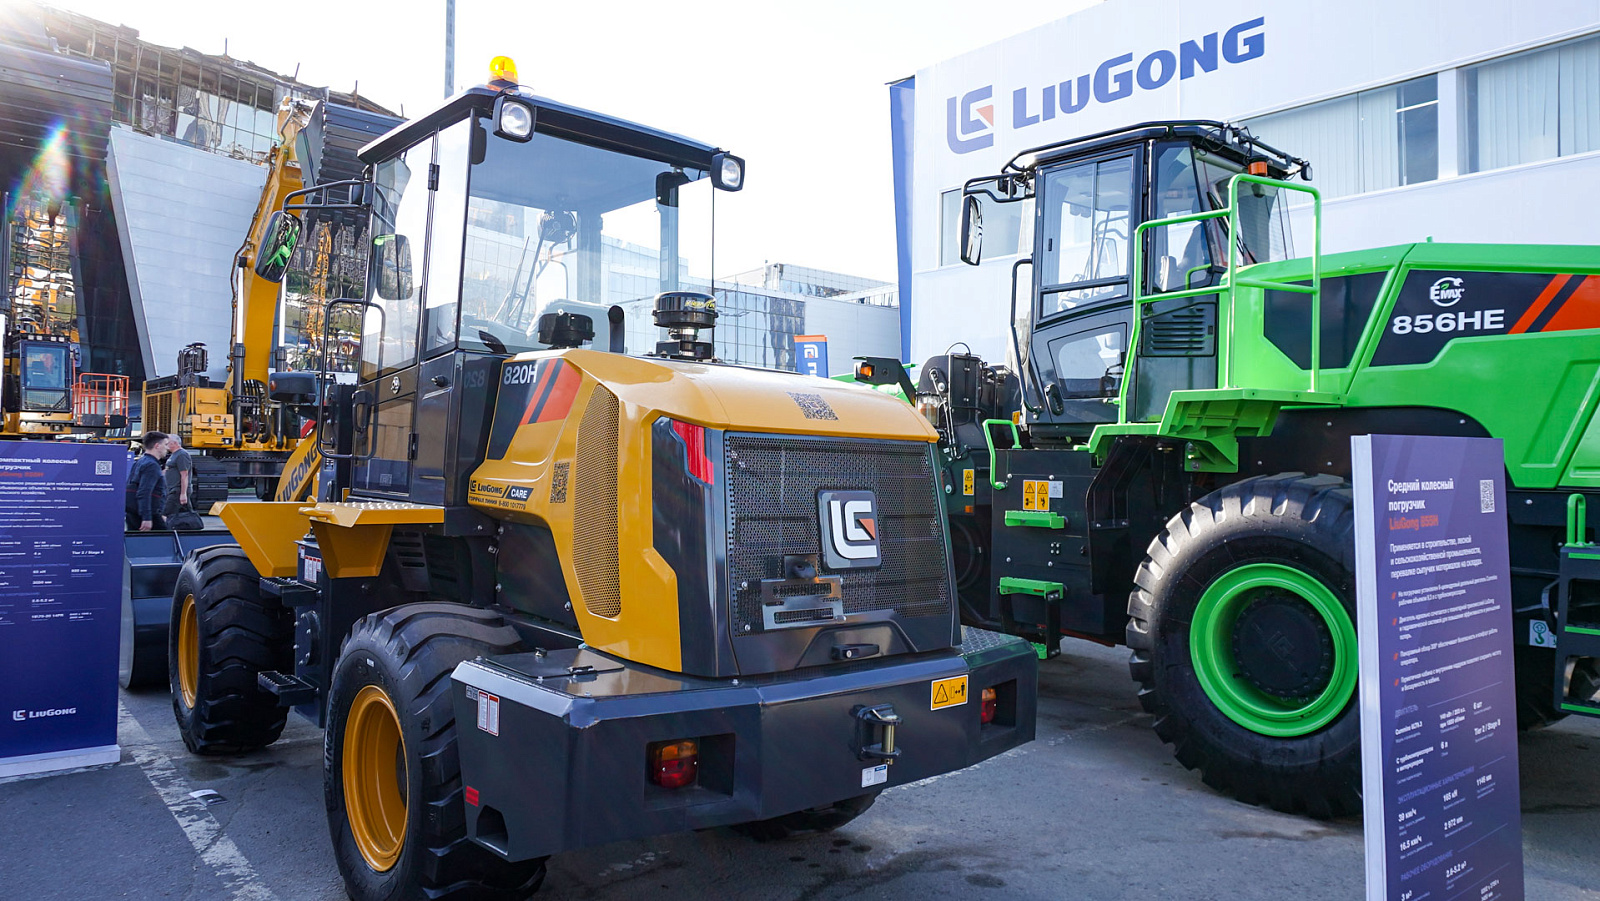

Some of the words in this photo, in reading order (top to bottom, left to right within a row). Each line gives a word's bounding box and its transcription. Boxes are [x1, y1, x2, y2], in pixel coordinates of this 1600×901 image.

[1013, 16, 1265, 130] LIUGONG
[1392, 309, 1505, 335] 856HE
[503, 364, 538, 385] 820H
[511, 488, 528, 499] CARE
[1388, 478, 1420, 494] Средний
[1421, 478, 1455, 490] колесный
[1388, 500, 1426, 513] погрузчик
[29, 707, 77, 719] LIUGONG
